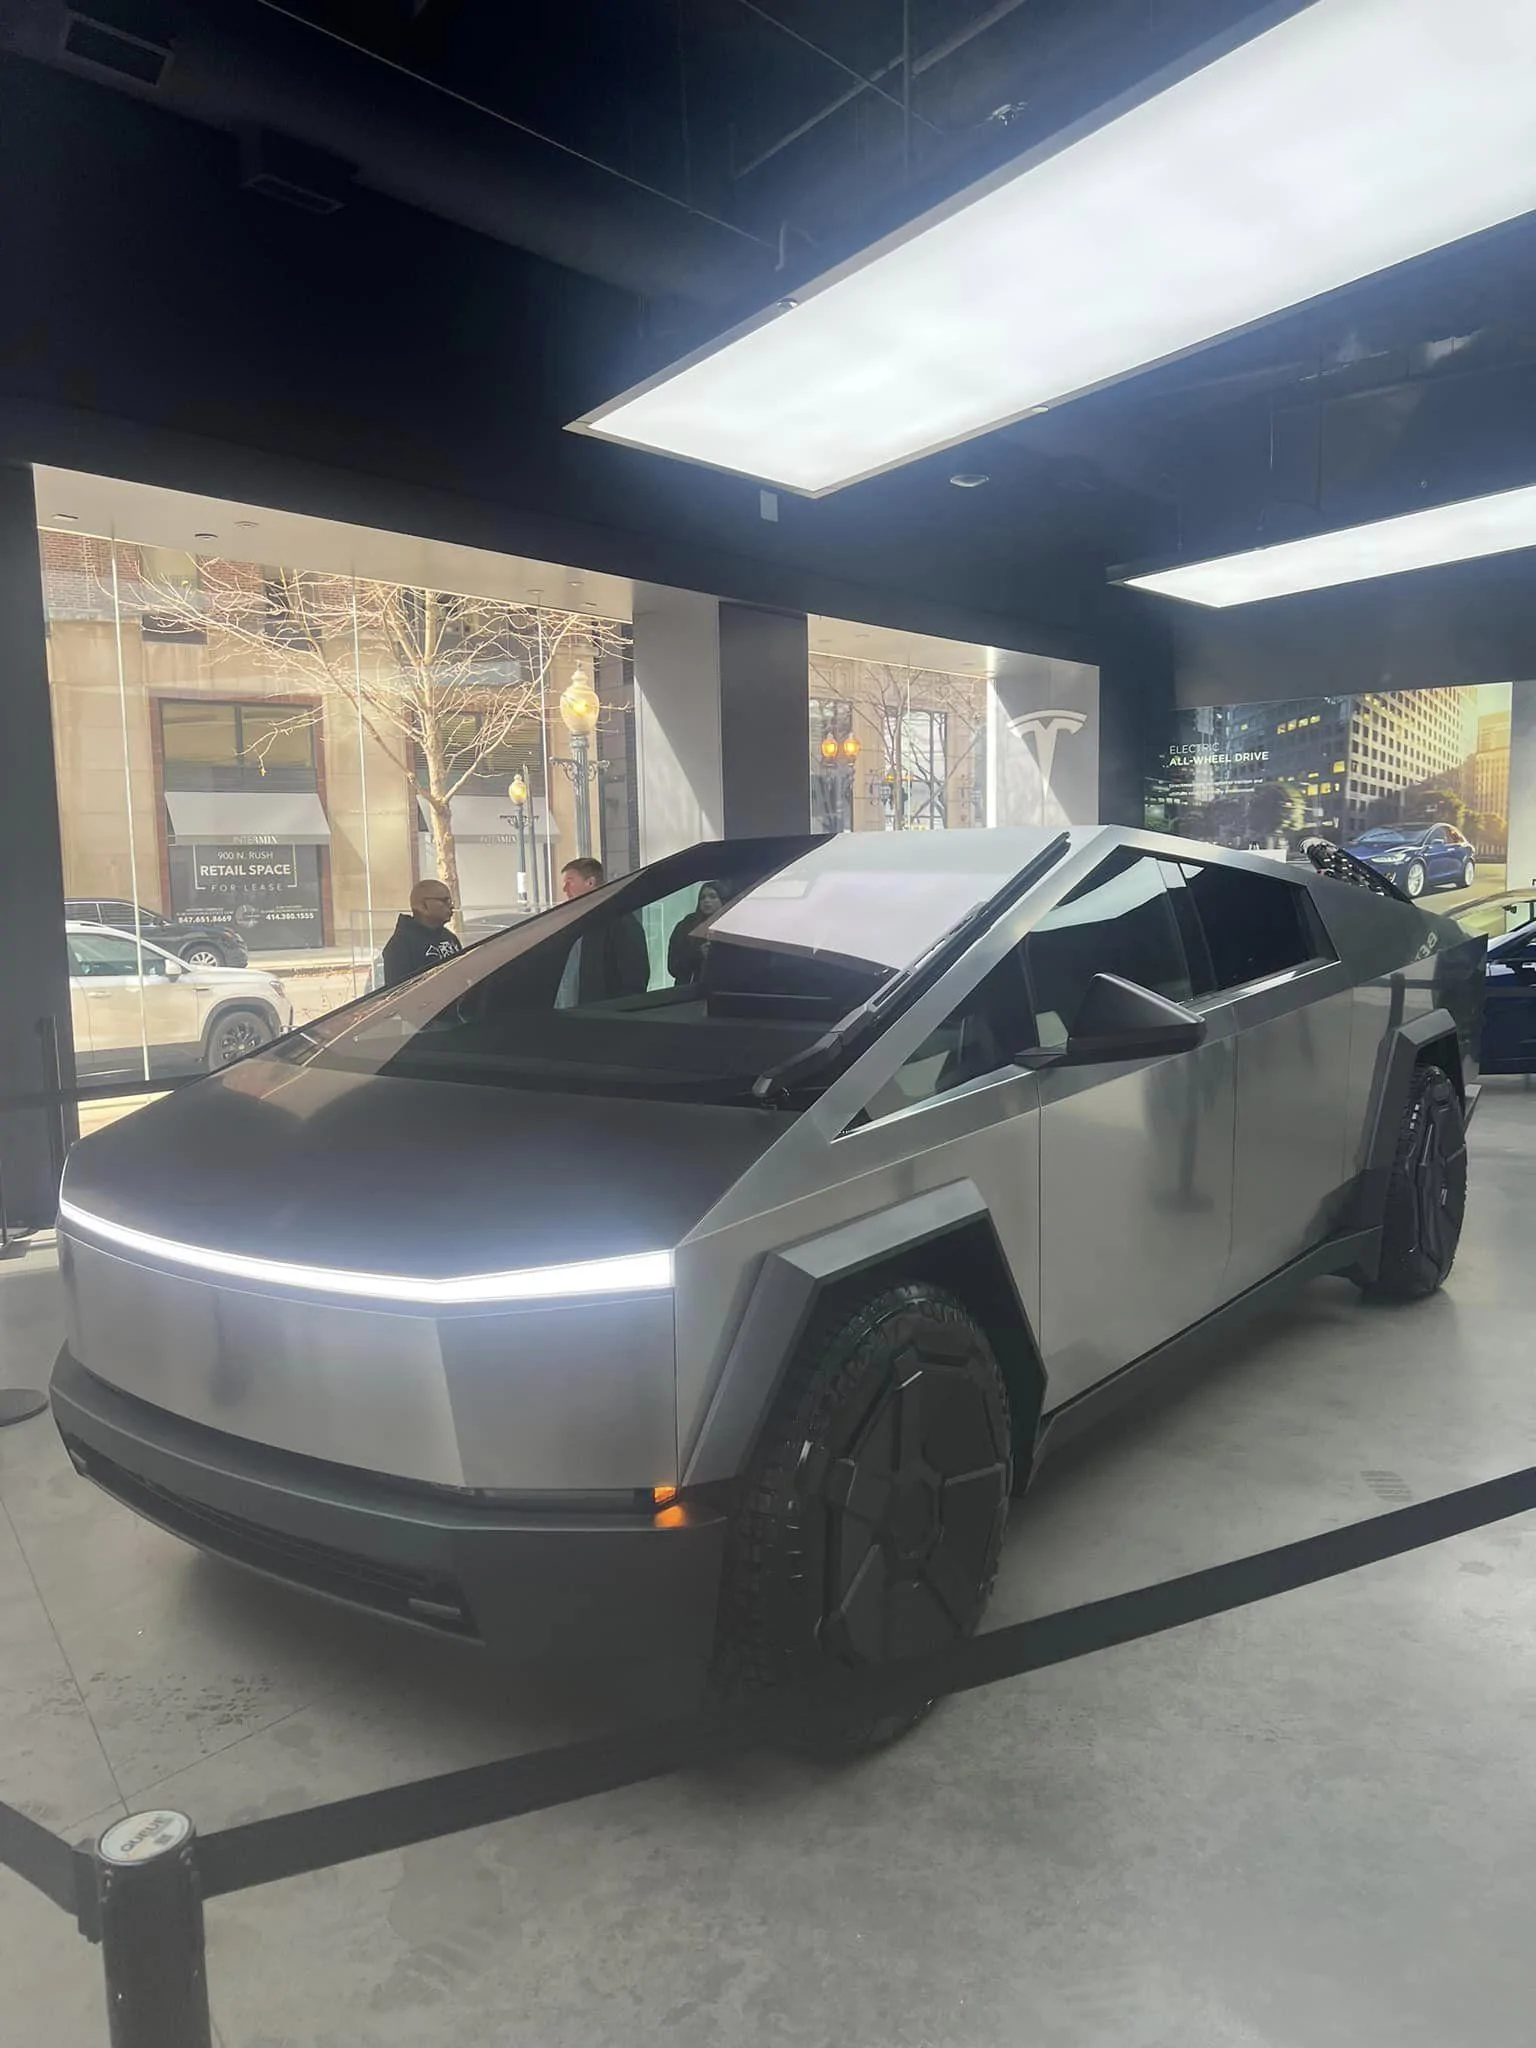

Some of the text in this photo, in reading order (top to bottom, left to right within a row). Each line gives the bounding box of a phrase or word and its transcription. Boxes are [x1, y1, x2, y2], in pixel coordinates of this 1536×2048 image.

[1169, 742, 1220, 754] ELECTRIC
[1168, 751, 1269, 766] ALL-WHEEL DRIVE
[217, 851, 234, 860] 900
[249, 851, 274, 860] RUSH
[200, 863, 291, 876] RETAIL SPACE
[210, 882, 283, 892] FOR LEASE
[120, 1815, 168, 1852] QUEUE
